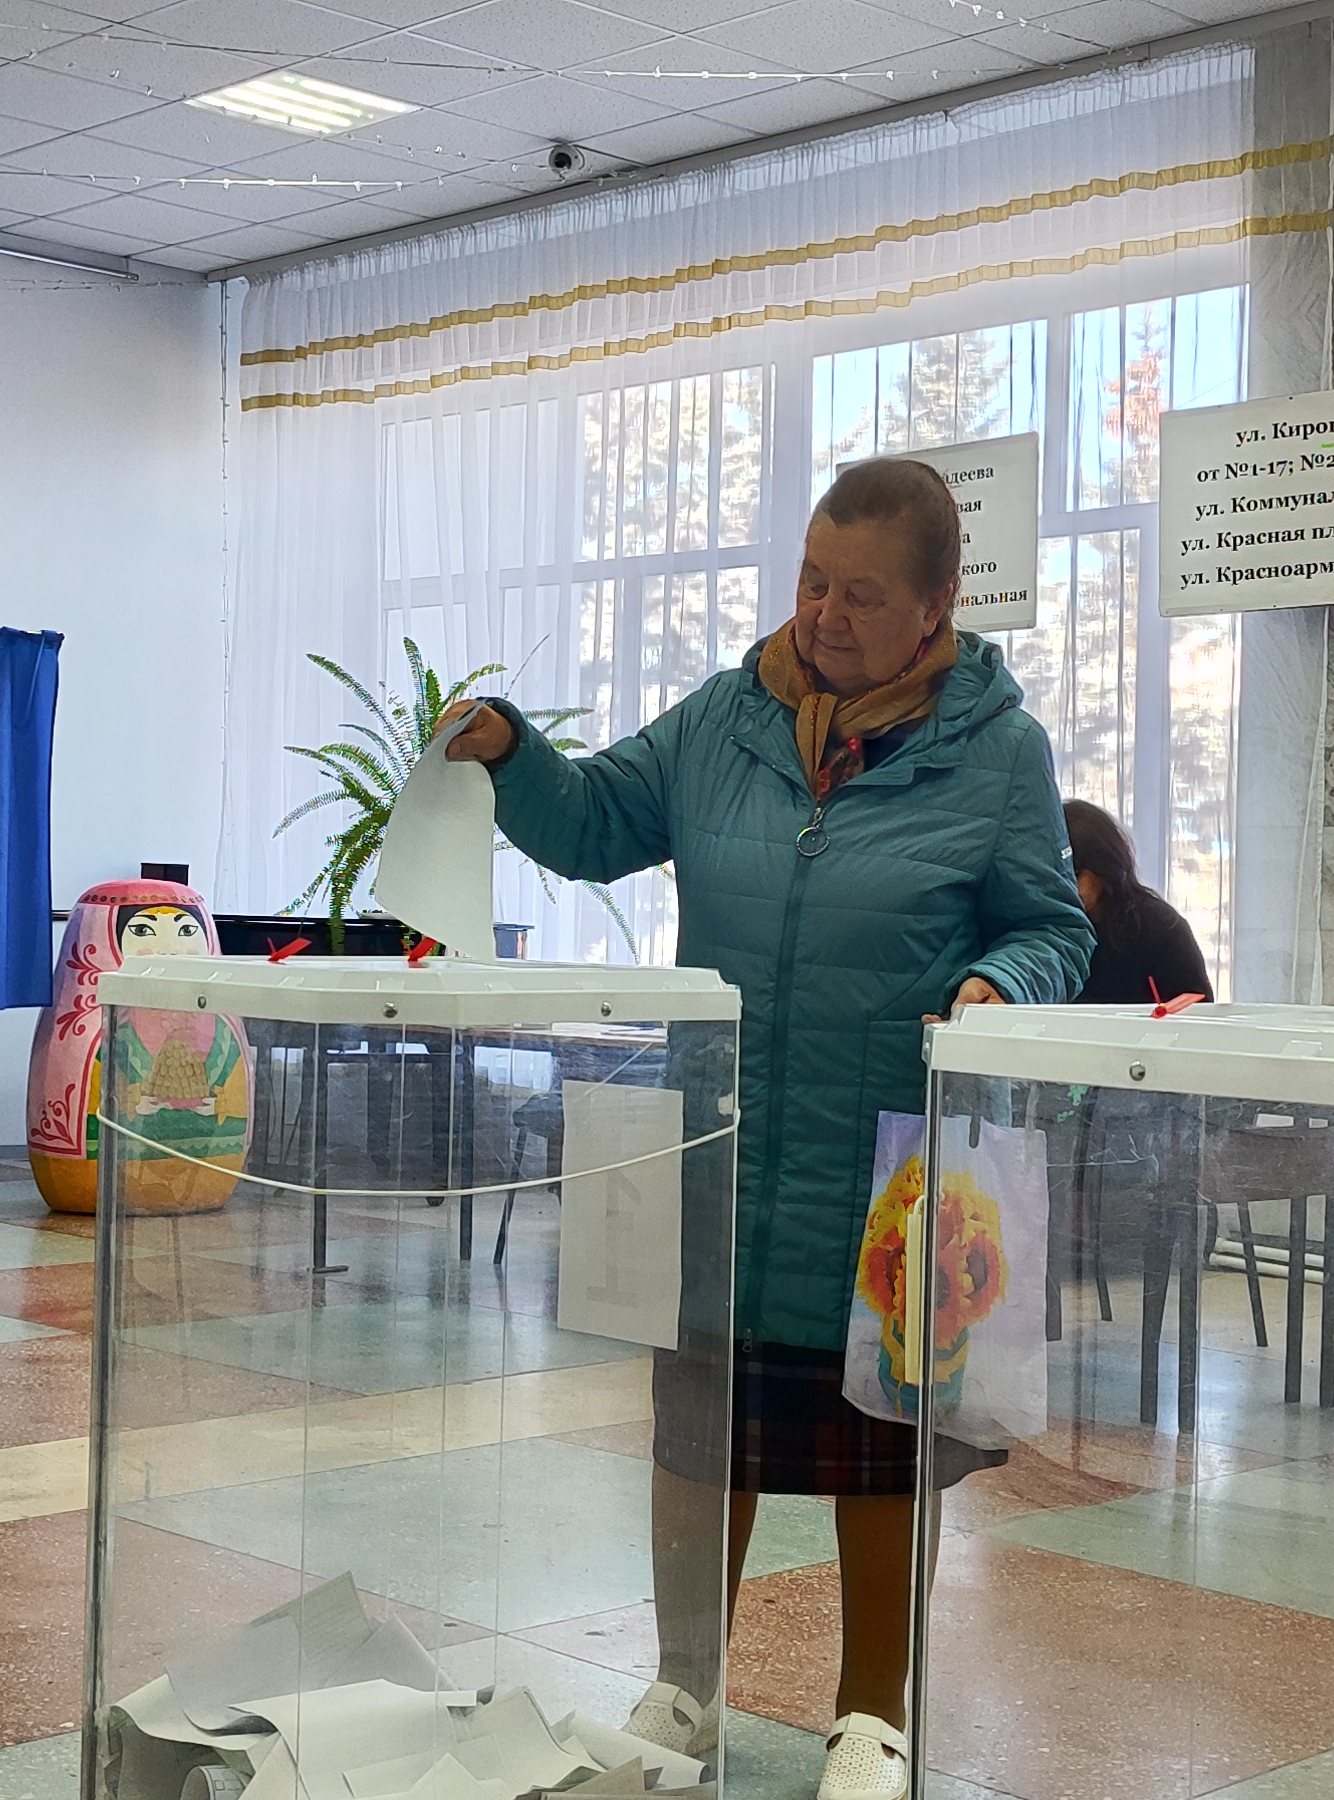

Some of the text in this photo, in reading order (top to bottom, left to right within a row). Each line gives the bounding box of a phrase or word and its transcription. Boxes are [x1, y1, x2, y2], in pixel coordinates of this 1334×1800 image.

[1236, 430, 1265, 447] ул.
[1197, 470, 1219, 482] от
[1225, 461, 1293, 479] №1-17;
[1196, 505, 1224, 521] ул.
[1181, 539, 1209, 556] ул.
[1217, 529, 1305, 551] Красная
[1181, 573, 1209, 590] ул.
